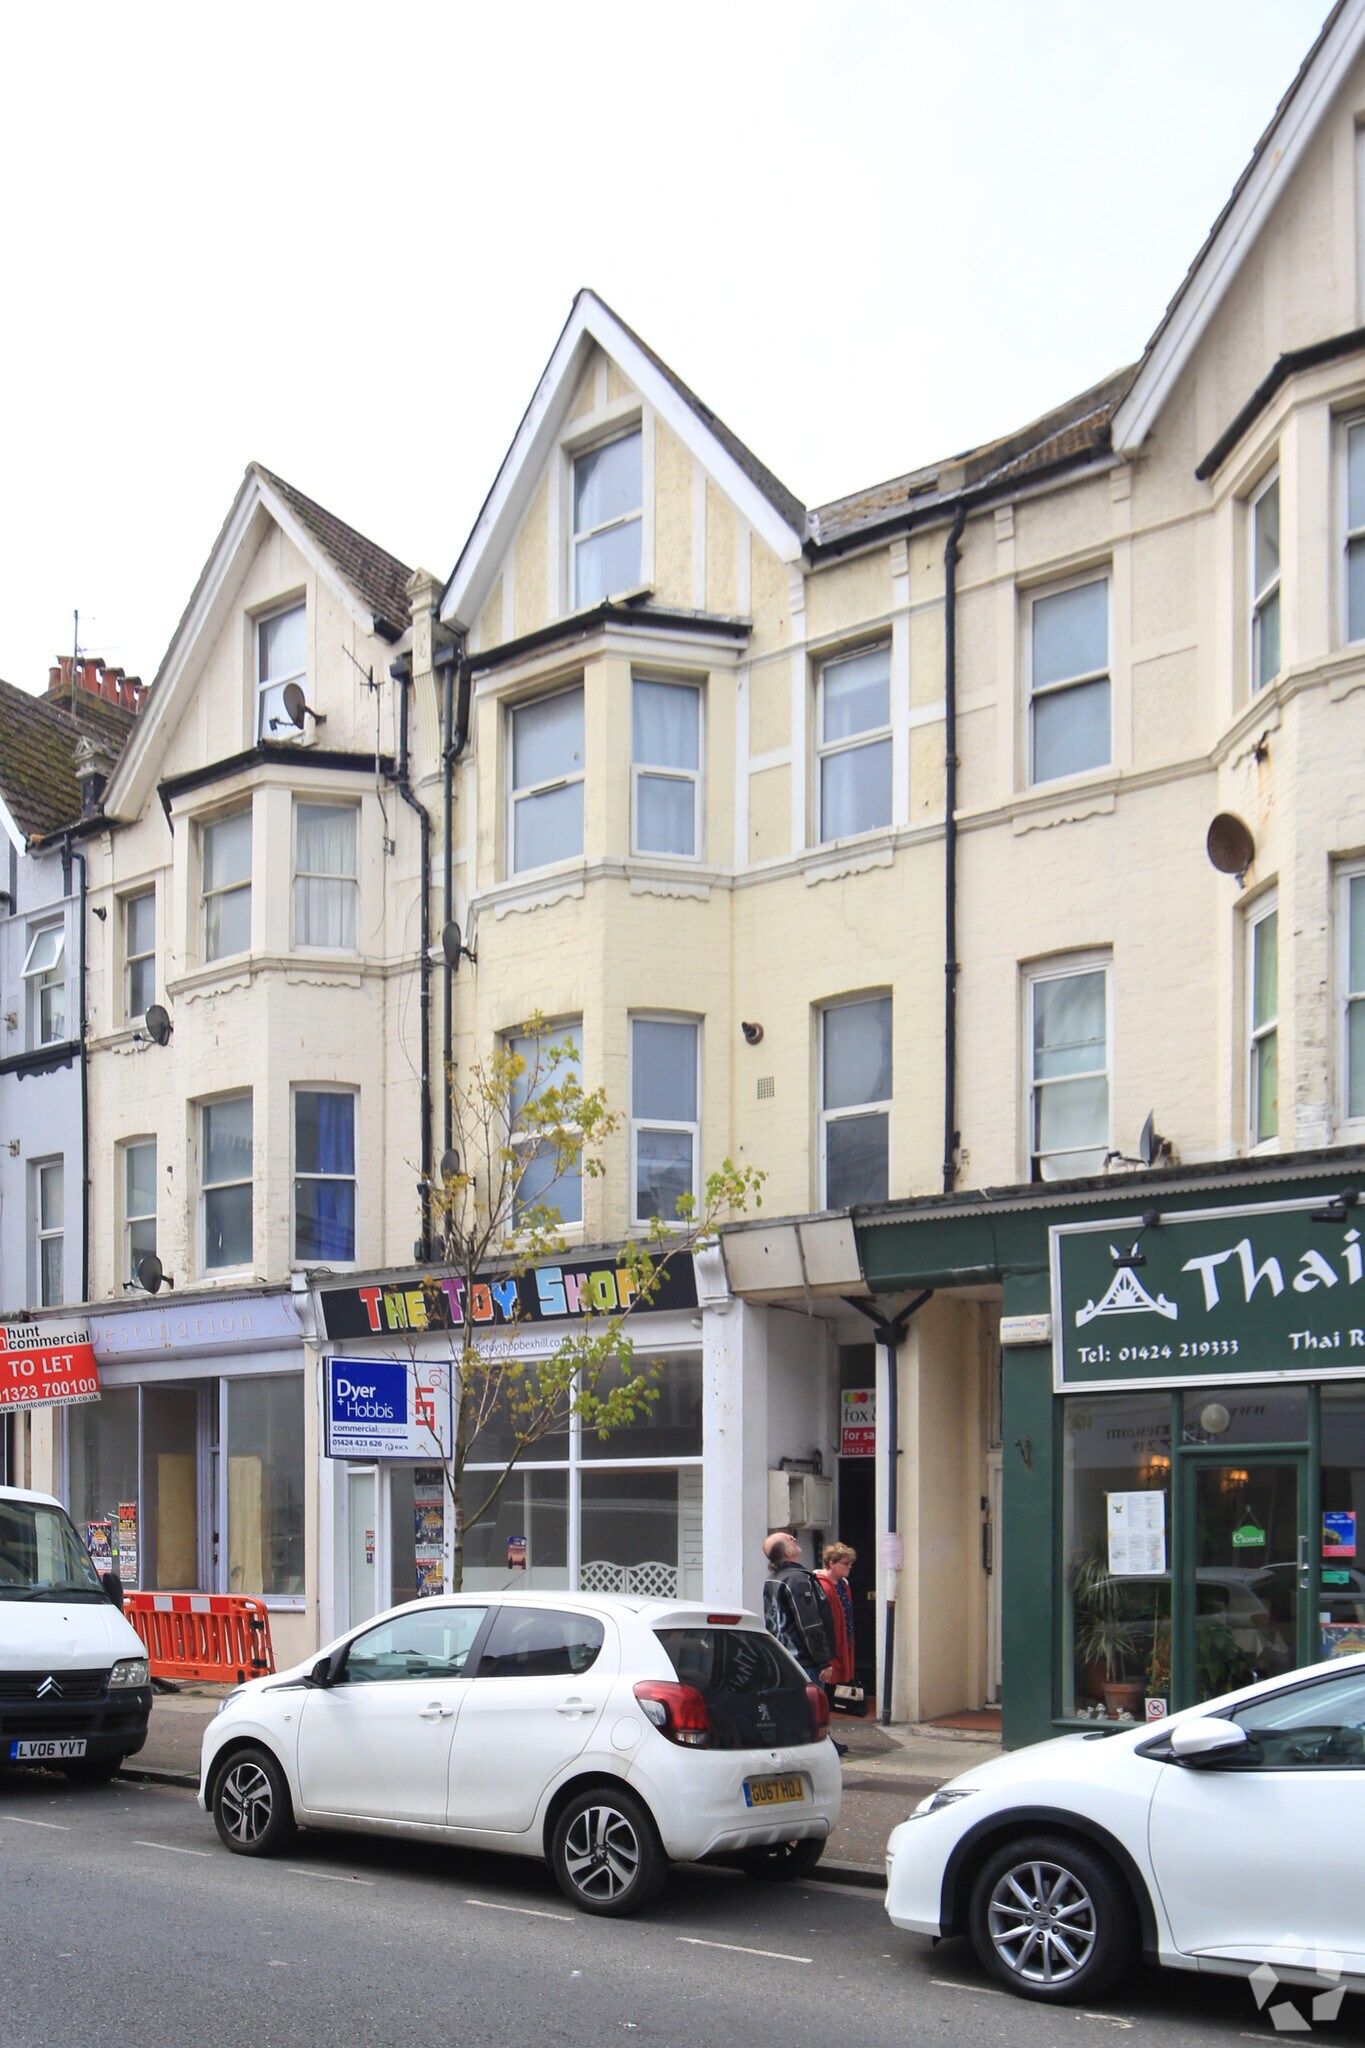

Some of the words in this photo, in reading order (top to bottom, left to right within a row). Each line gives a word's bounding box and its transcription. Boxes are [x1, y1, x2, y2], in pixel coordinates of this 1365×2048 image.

[1180, 1228, 1364, 1313] Thai
[440, 1277, 518, 1325] TOY
[7, 1325, 40, 1340] hunt
[9, 1330, 90, 1350] commercial
[1288, 1329, 1340, 1351] Thai
[1077, 1344, 1111, 1364] Tel:
[1118, 1344, 1172, 1361] 01424
[1179, 1339, 1239, 1358] 219333
[8, 1359, 35, 1377] TO
[42, 1354, 74, 1374] LET
[42, 1377, 97, 1397] 700100
[336, 1378, 377, 1402] Dyer
[347, 1401, 394, 1419] Hobbis
[415, 1387, 435, 1432] LET
[844, 1407, 868, 1423] fox
[354, 1440, 368, 1448] 423
[369, 1440, 382, 1448] 626
[843, 1429, 861, 1441] for
[19, 1742, 55, 1757] LV06
[60, 1741, 84, 1756] YVT
[751, 1782, 779, 1802] GU67
